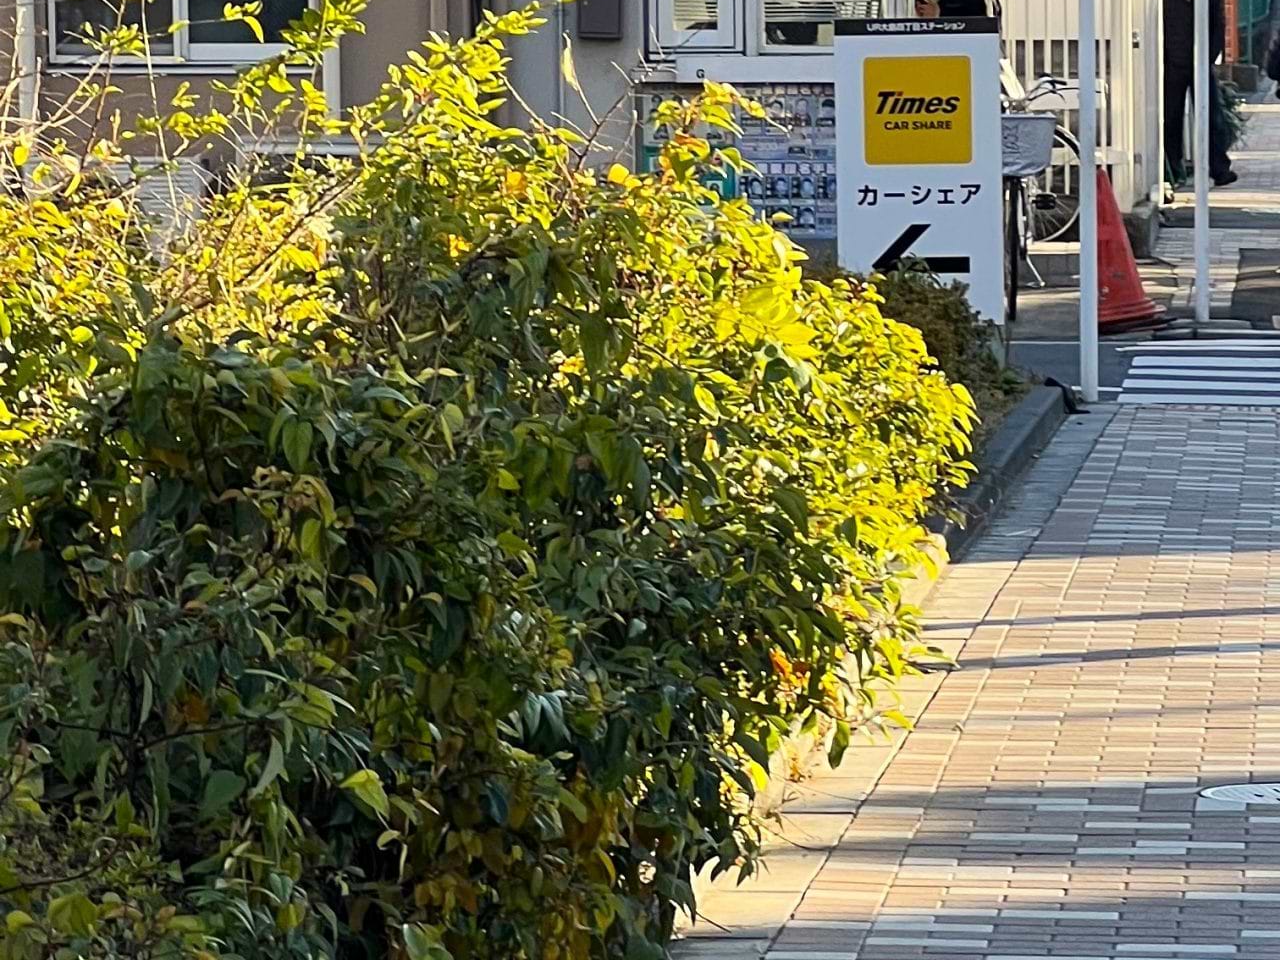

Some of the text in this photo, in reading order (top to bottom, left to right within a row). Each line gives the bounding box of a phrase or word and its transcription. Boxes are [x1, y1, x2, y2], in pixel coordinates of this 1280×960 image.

[875, 90, 961, 115] Times
[883, 120, 953, 131] CAR SHARE
[857, 183, 982, 206] カーシェア
